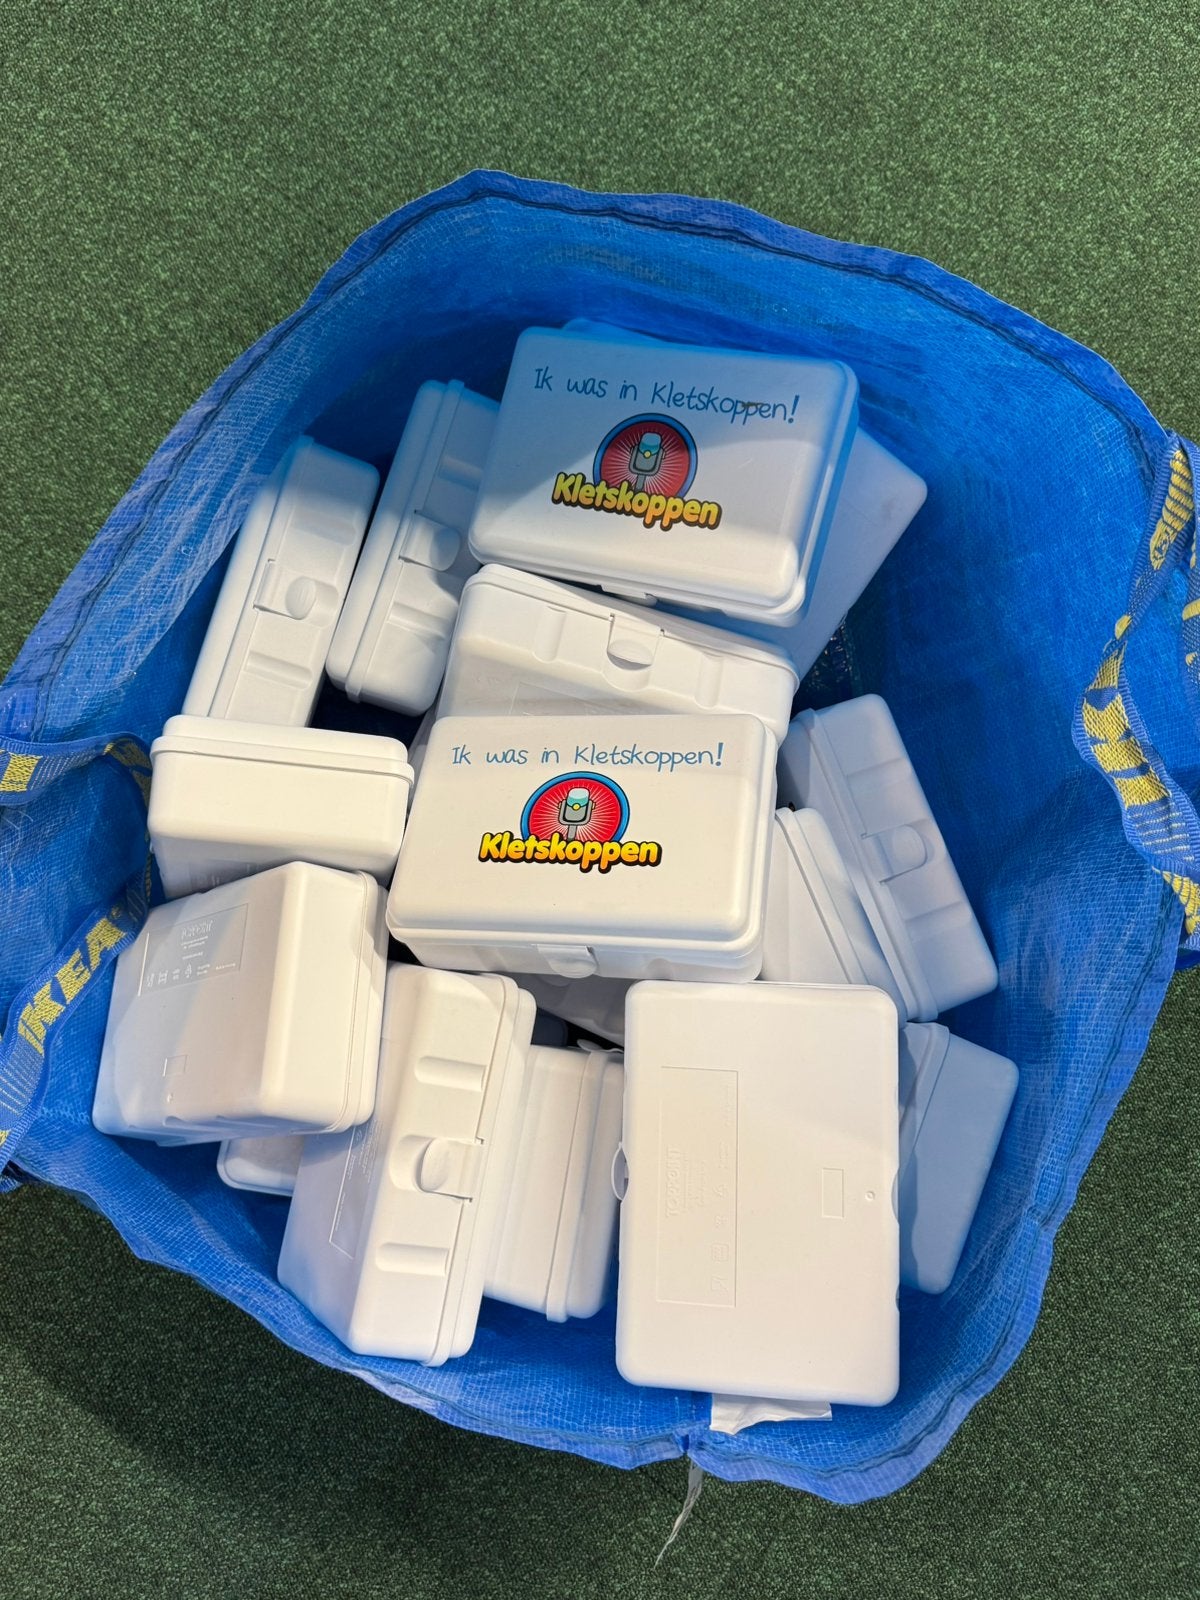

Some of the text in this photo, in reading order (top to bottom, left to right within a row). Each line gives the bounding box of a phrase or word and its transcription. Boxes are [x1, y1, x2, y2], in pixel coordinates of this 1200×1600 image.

[534, 366, 800, 426] Ik was in Kletskoppen!
[552, 473, 722, 530] Kletskoppen
[451, 742, 724, 772] Ik was in Kletskoppen!
[478, 831, 662, 873] Kletskoppen
[17, 916, 126, 1057] IKEA
